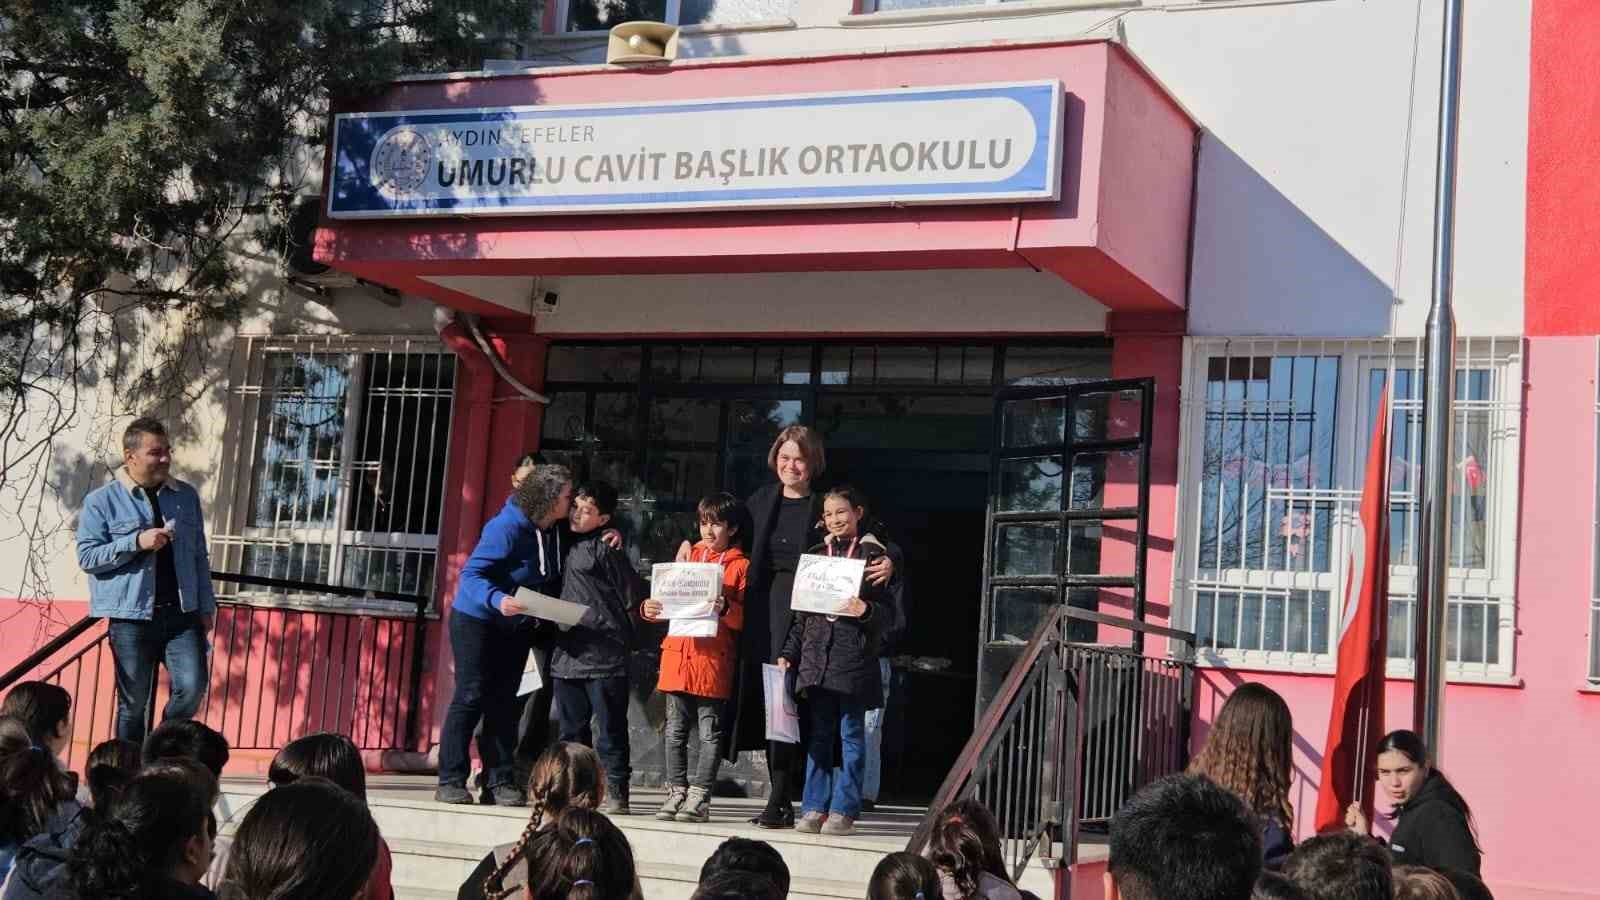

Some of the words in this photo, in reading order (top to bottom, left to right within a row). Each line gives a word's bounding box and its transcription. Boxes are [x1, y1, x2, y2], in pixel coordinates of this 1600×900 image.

[521, 125, 596, 143] EFELER
[437, 155, 566, 188] UMURLU
[574, 147, 667, 183] CAVİT
[674, 147, 790, 185] BAŞLIK
[798, 138, 1012, 175] ORTAOKULU
